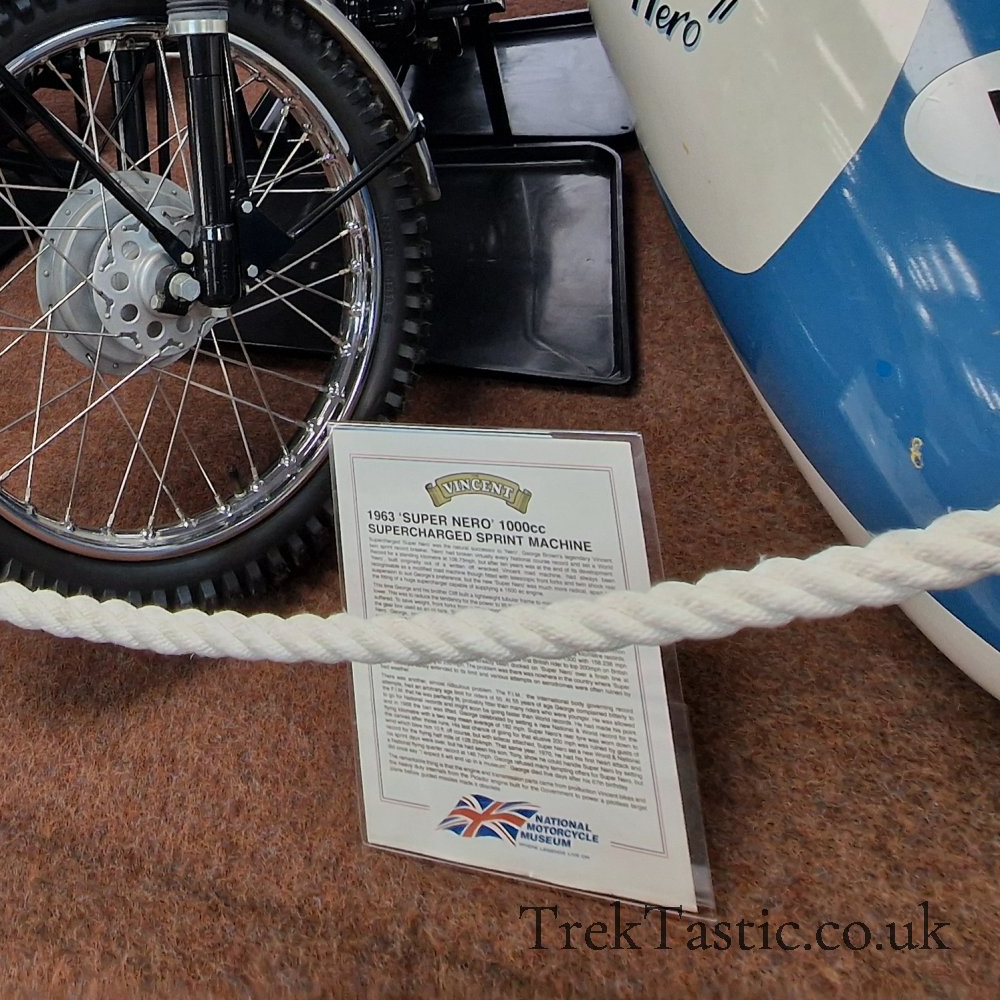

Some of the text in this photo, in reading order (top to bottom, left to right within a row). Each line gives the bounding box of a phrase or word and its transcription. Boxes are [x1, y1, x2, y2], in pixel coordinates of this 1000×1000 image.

[442, 477, 515, 499] VINCENT
[367, 509, 396, 523] 1963
[499, 519, 547, 534] 1000cc
[367, 522, 593, 553] SUPERCHARGED SPRINT MACHINE
[526, 822, 599, 844] MOTORCYCLE
[535, 814, 592, 833] NATIONAL
[520, 831, 572, 849] MUSEUM
